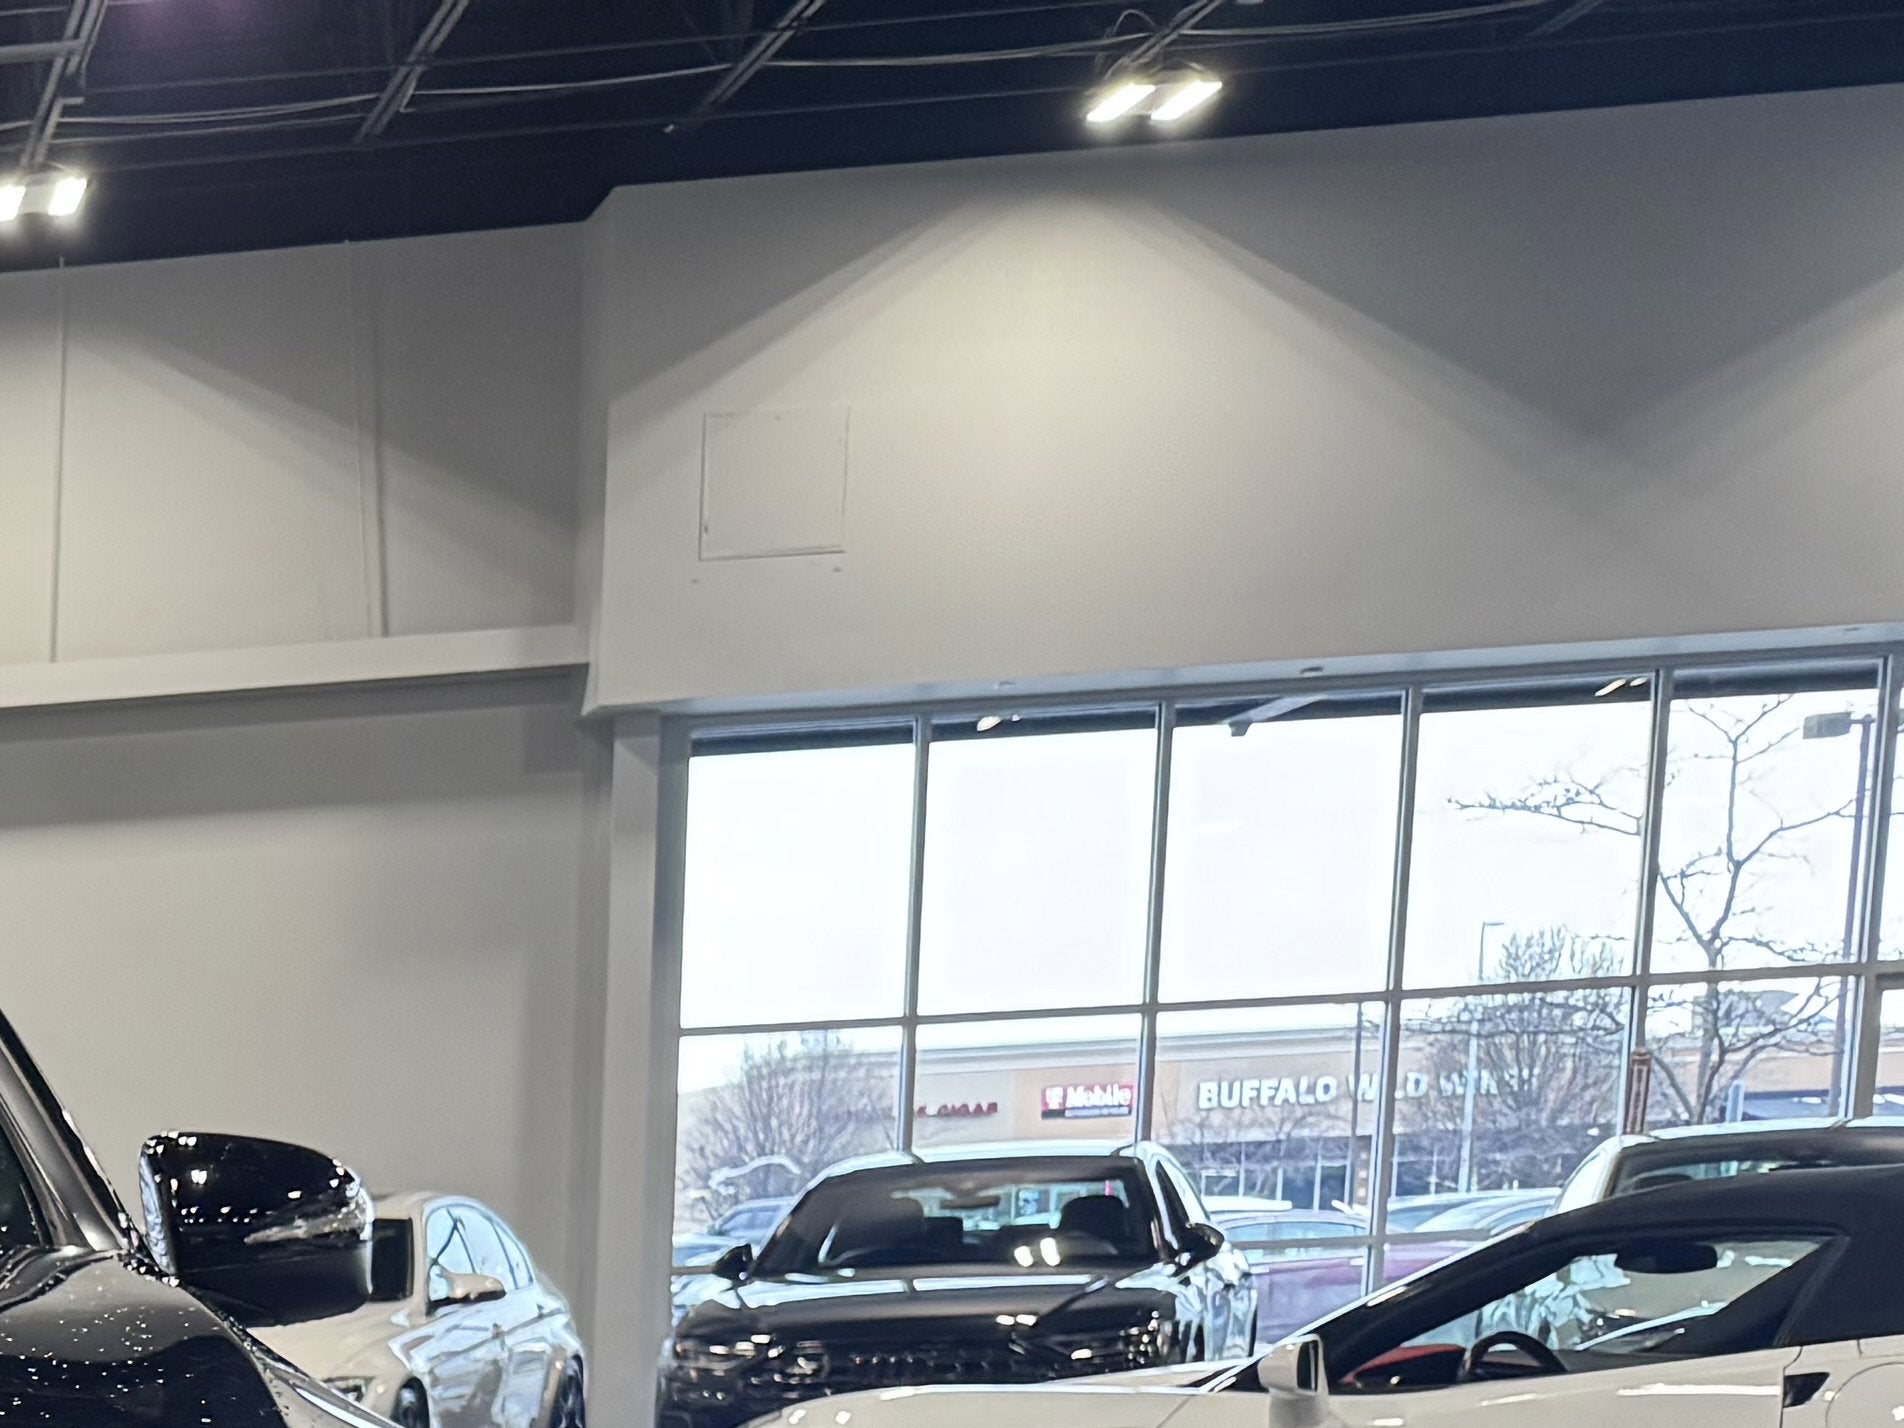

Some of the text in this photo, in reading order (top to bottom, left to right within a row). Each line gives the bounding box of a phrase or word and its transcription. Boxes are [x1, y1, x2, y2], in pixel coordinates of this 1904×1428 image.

[1065, 1083, 1131, 1108] Mobile
[1198, 1075, 1338, 1109] BUFFALO
[1347, 1072, 1428, 1101] WD
